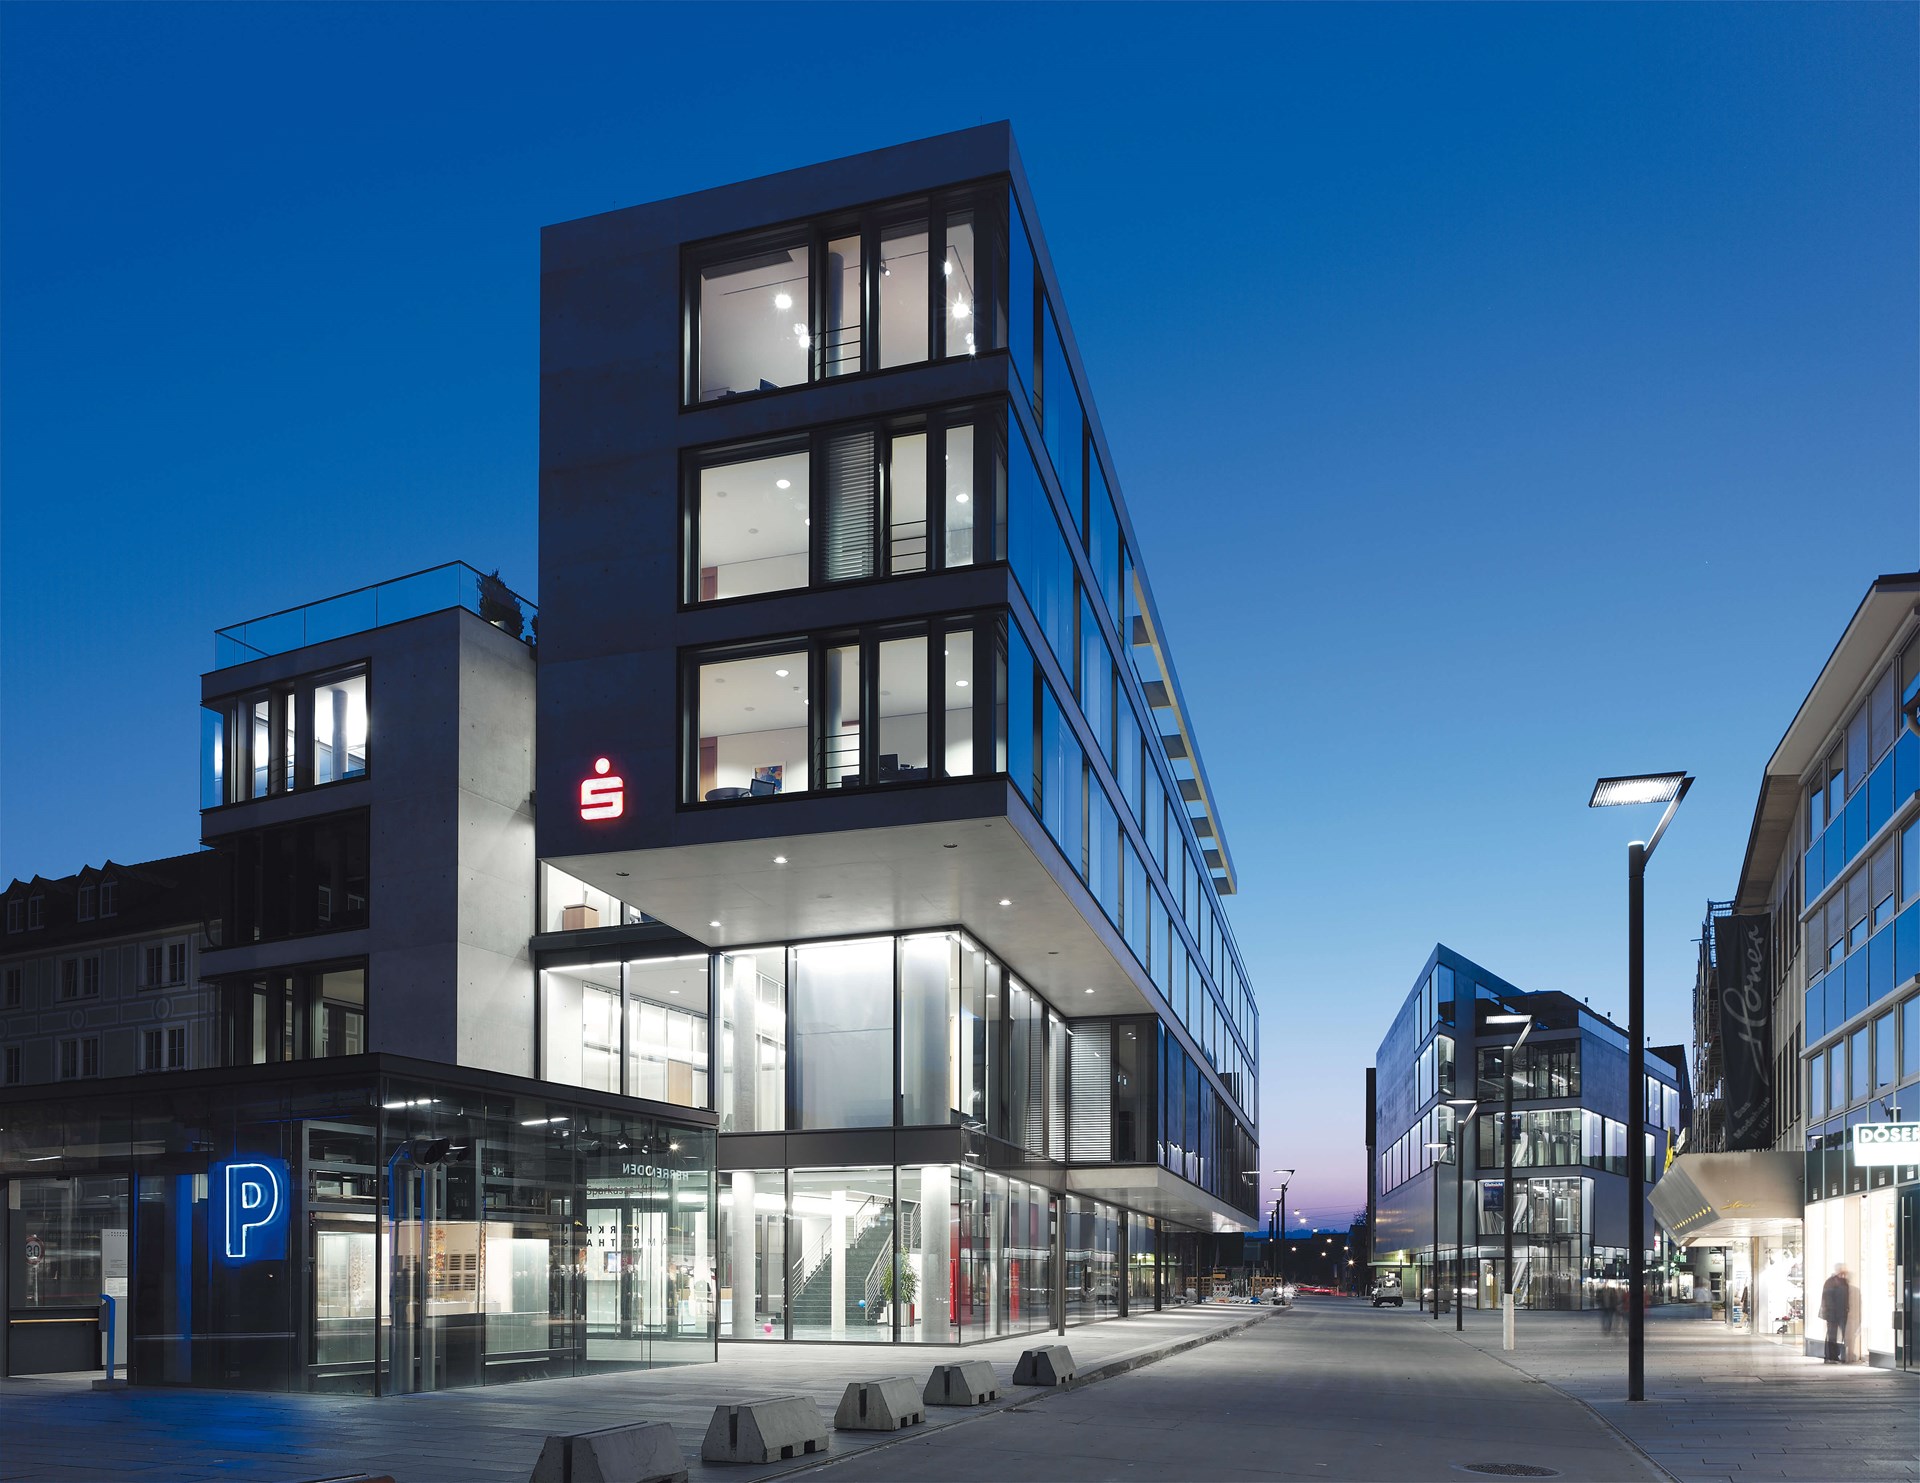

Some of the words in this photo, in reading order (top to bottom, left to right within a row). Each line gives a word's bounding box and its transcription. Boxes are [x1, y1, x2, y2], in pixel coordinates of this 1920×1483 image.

[1722, 924, 1770, 1087] Honer
[1733, 1102, 1751, 1119] Das
[1733, 1097, 1771, 1139] Modehaus
[226, 1163, 279, 1258] P
[26, 1245, 41, 1258] 30
